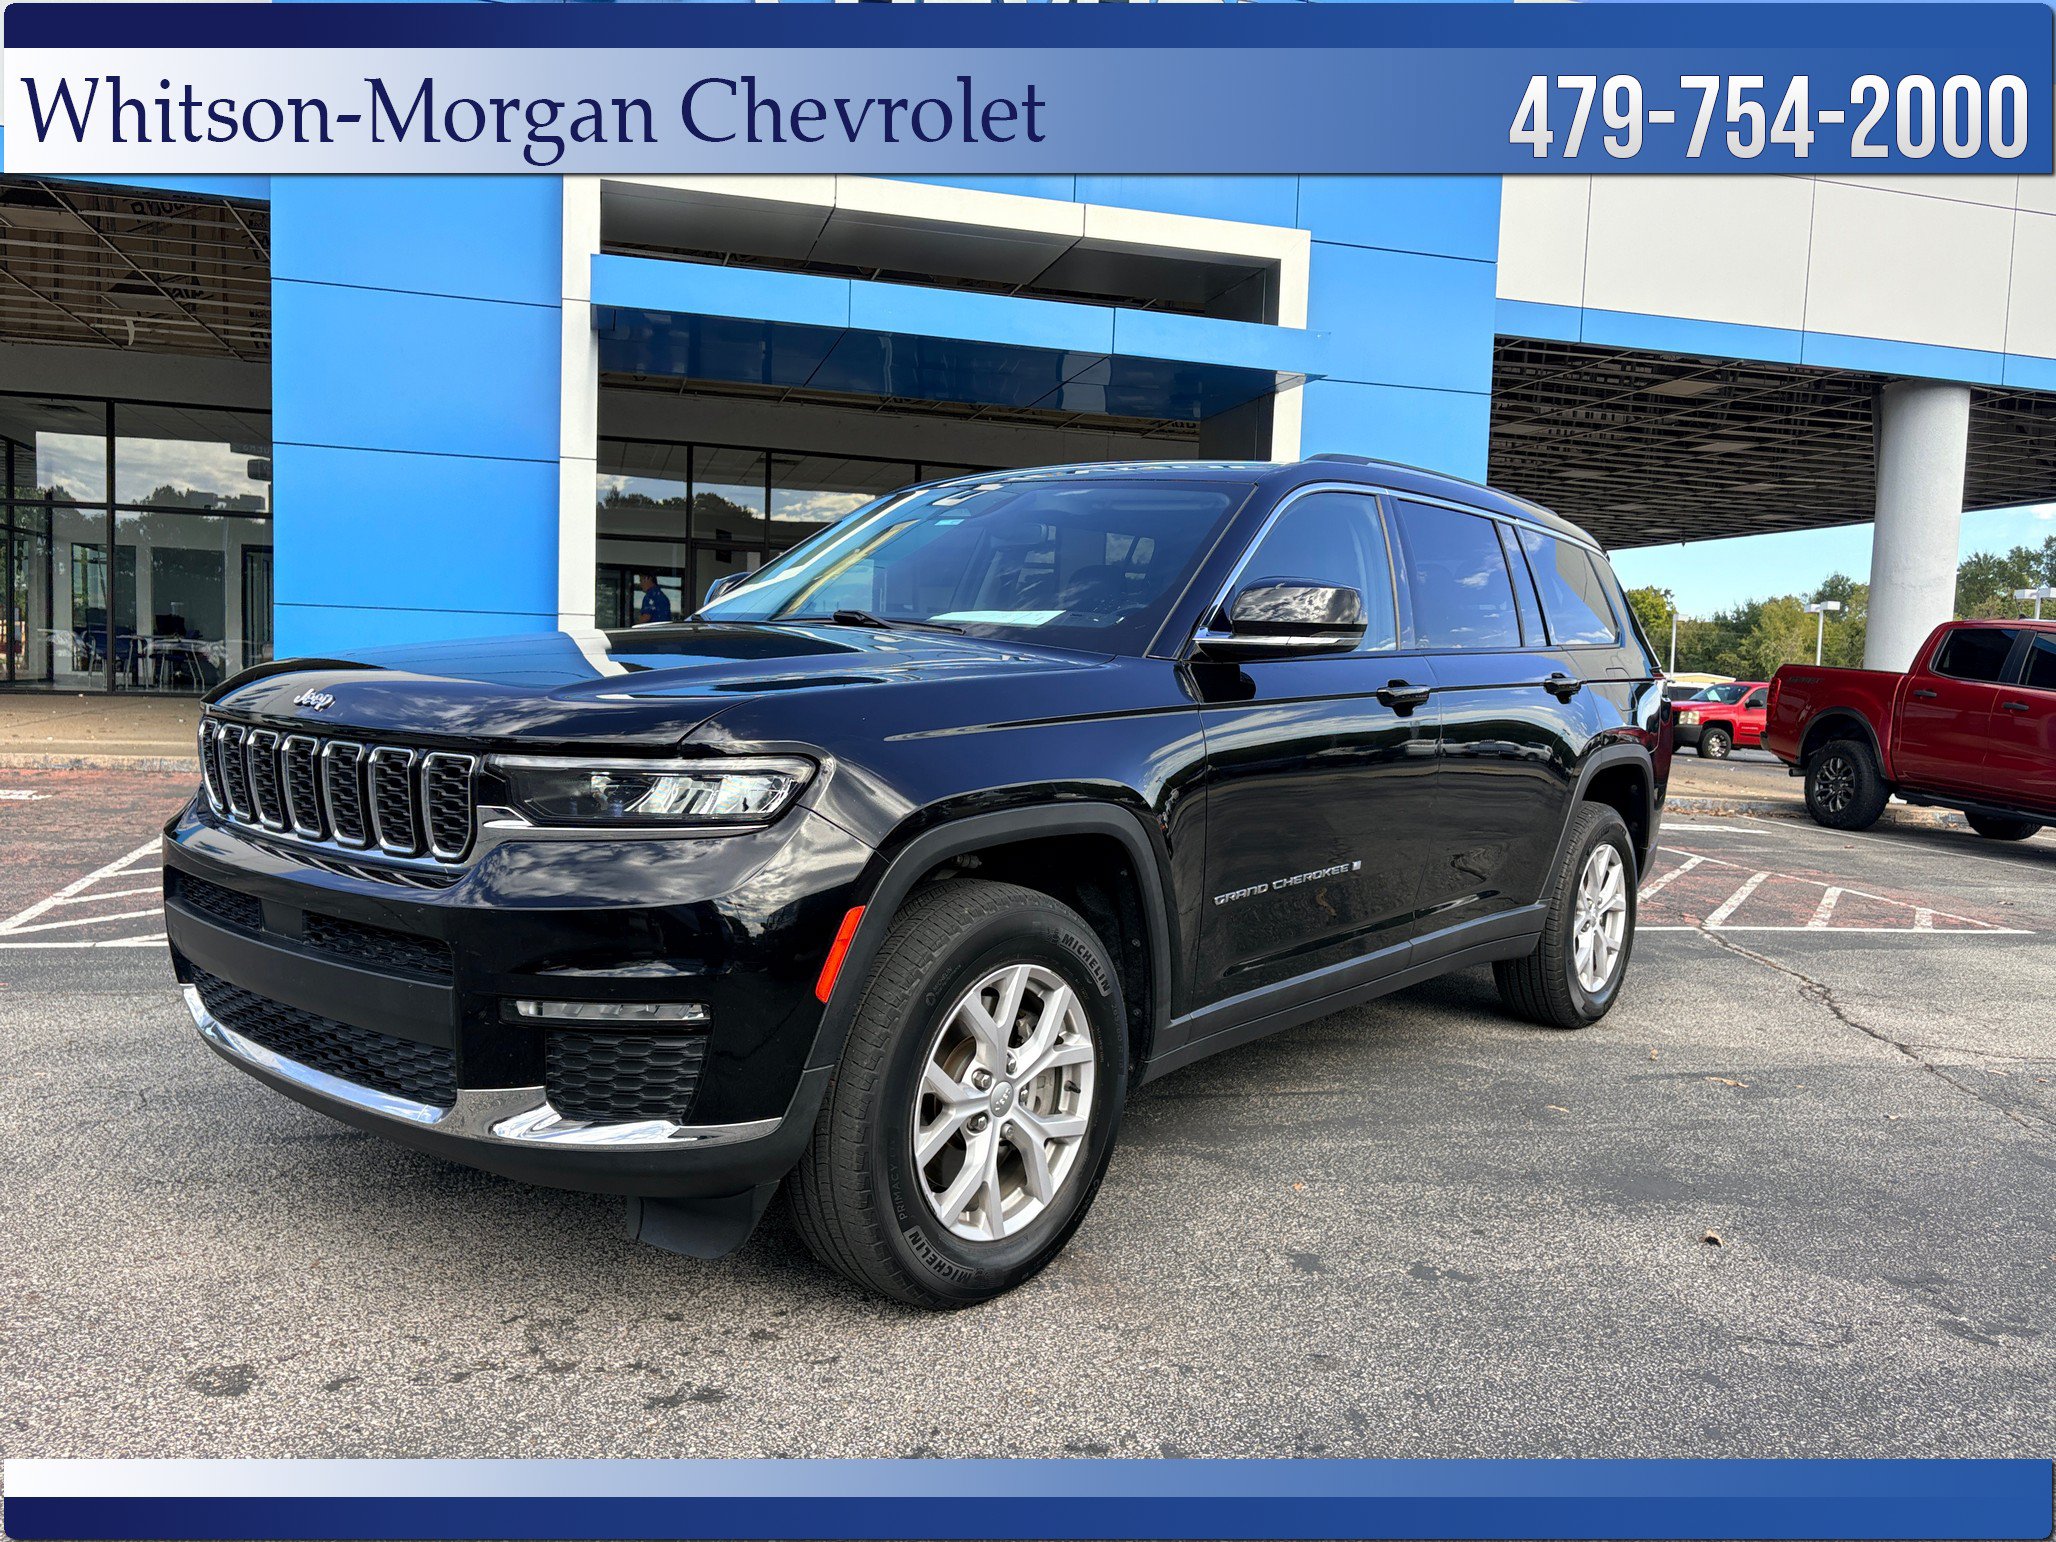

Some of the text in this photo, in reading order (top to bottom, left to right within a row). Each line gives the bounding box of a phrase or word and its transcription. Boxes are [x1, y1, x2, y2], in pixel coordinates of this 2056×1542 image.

[293, 687, 337, 712] Jeep
[1213, 883, 1269, 906] GRAND
[1272, 863, 1350, 890] CHEROKEE
[1061, 932, 1111, 992] MICHELIN
[908, 1230, 972, 1284] MICHELIN
